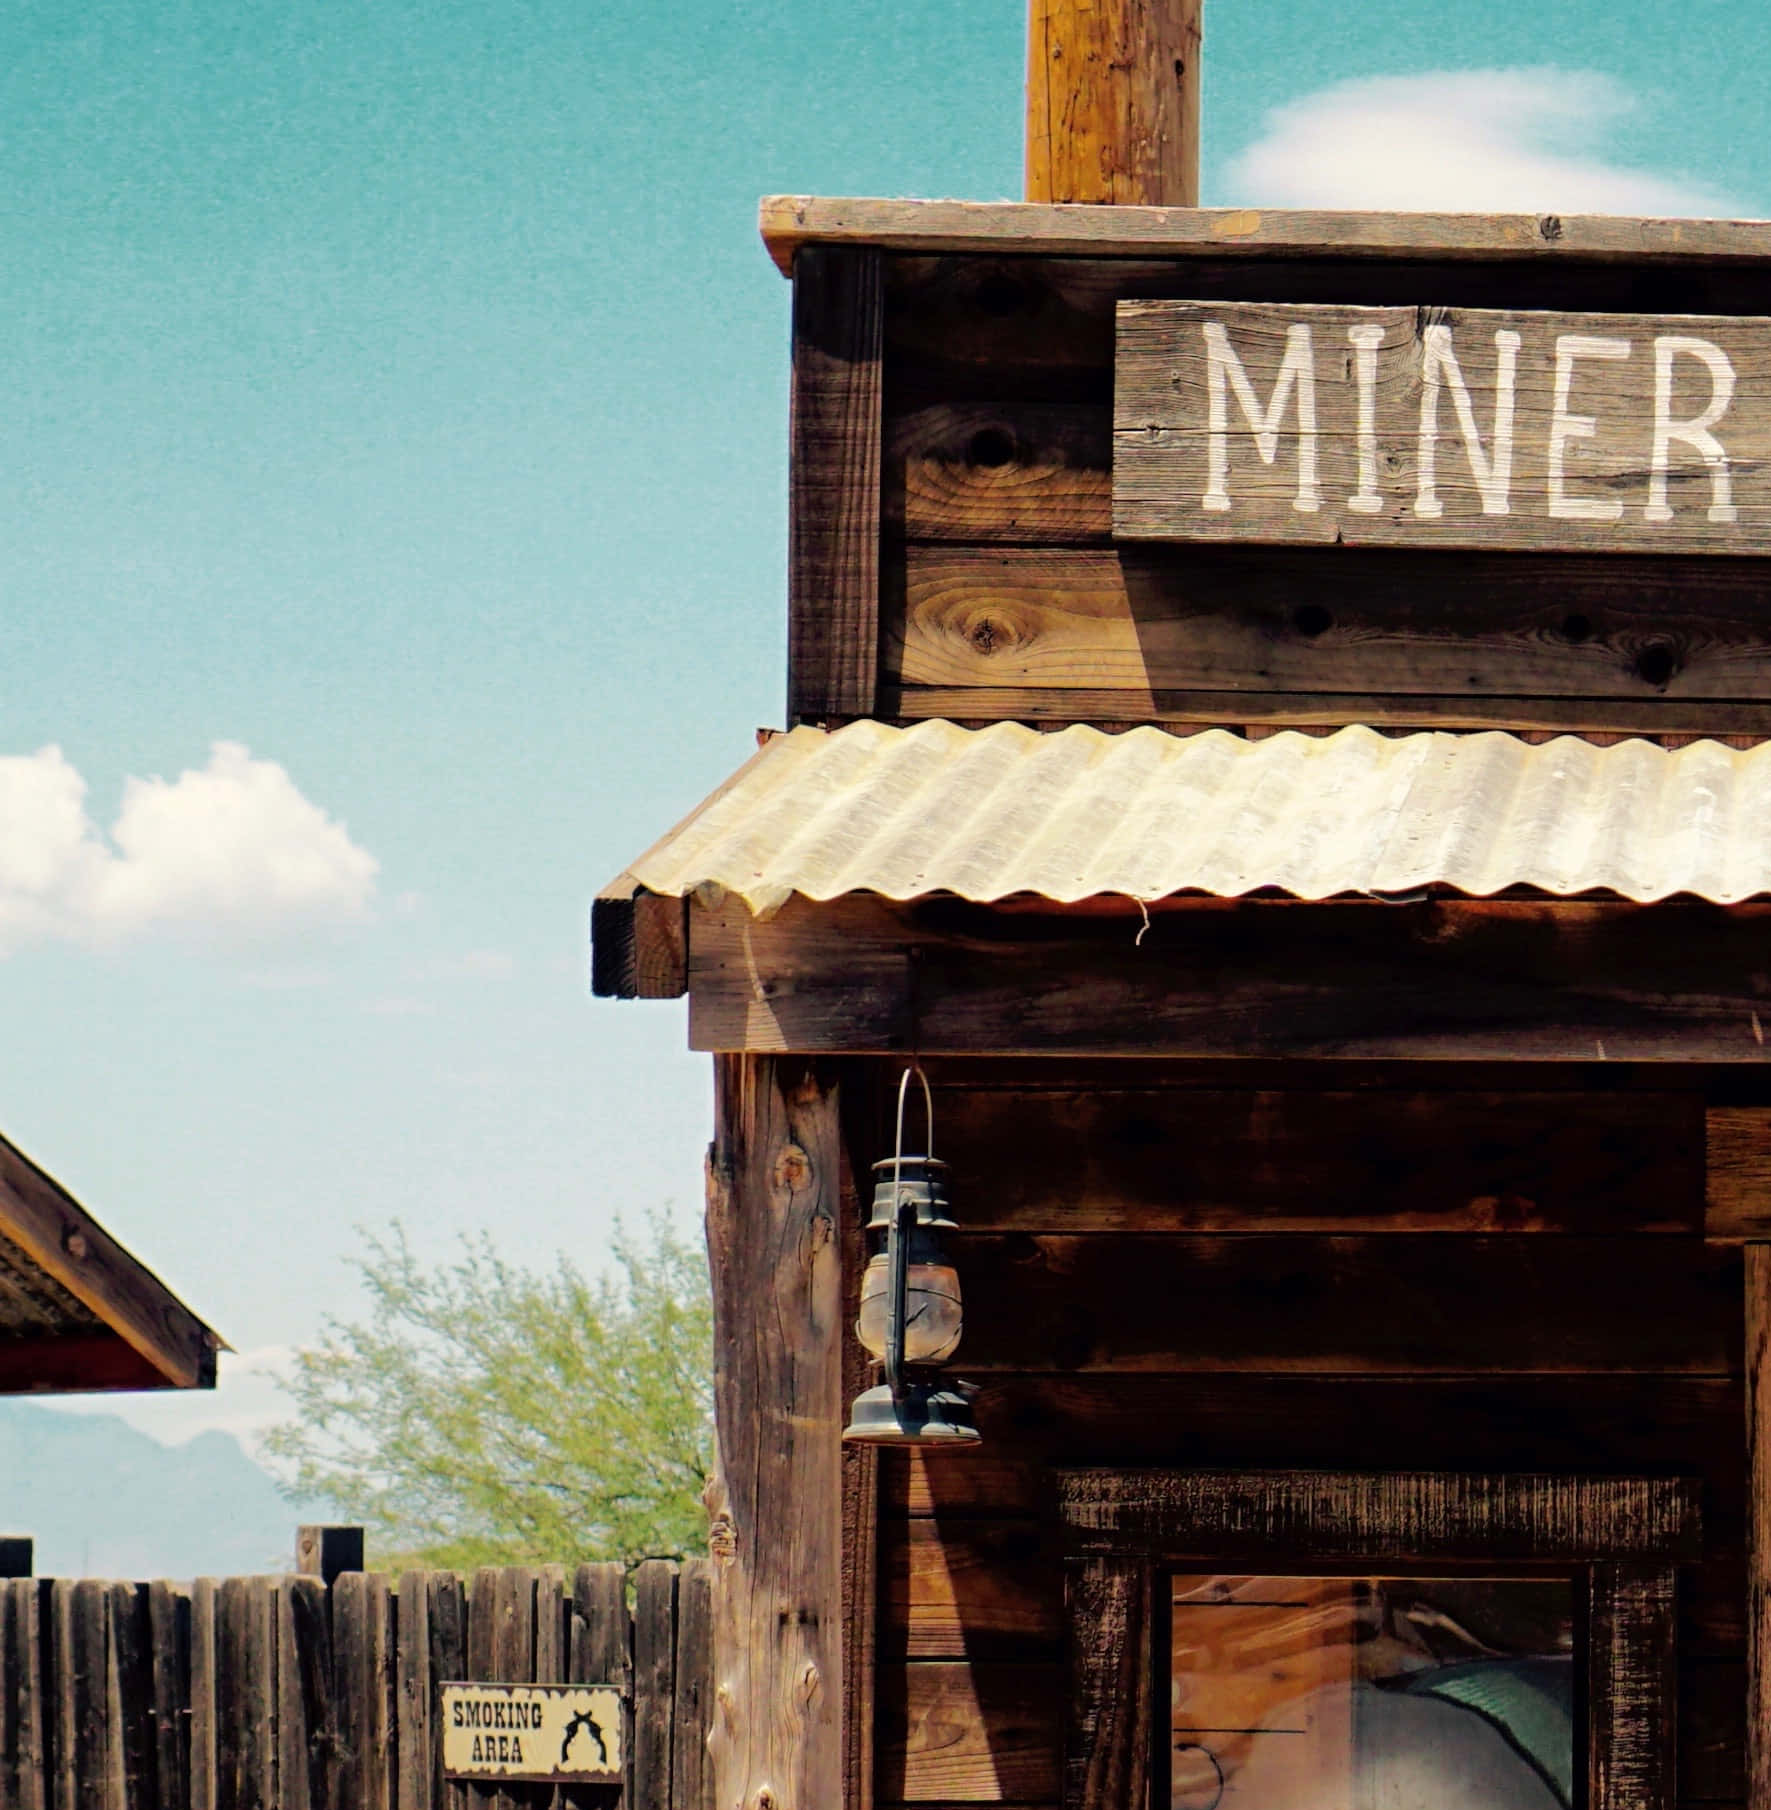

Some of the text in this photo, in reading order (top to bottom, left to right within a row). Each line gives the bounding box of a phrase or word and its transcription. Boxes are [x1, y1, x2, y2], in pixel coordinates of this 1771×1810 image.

[1202, 320, 1741, 522] MINER
[453, 1700, 543, 1729] SMOKING
[471, 1735, 524, 1763] AREA
